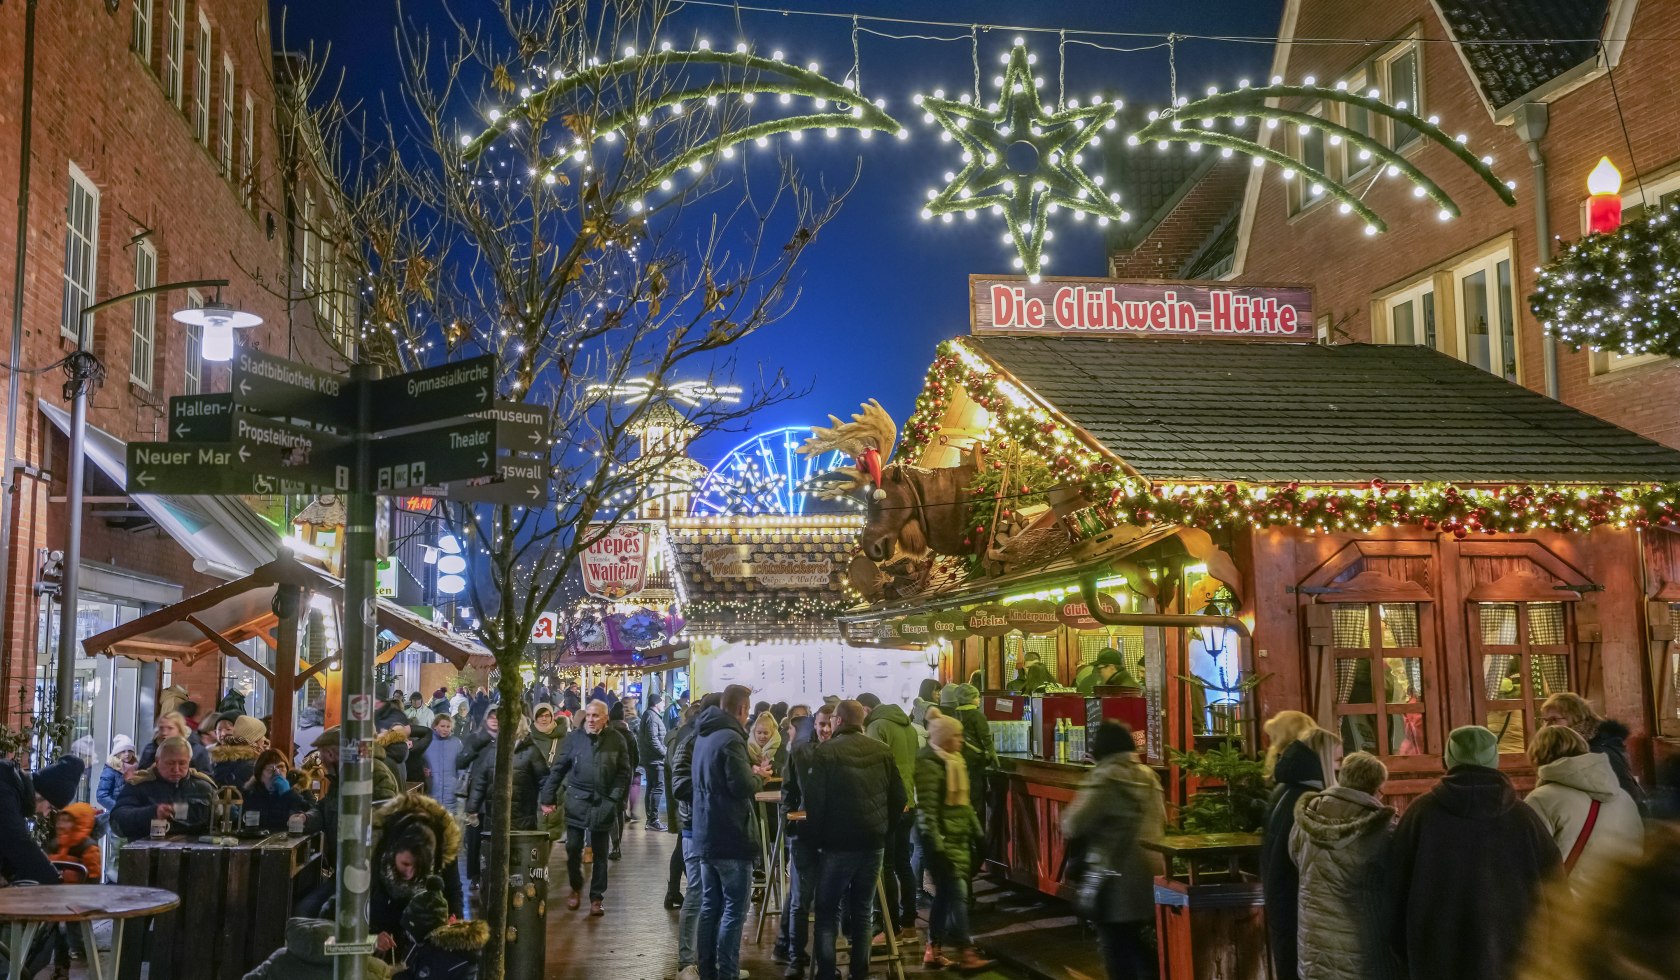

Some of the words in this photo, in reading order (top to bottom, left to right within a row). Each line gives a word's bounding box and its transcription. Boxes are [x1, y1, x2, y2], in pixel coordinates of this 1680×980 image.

[990, 284, 1045, 328] Die
[1053, 286, 1298, 334] Glühwein-Hütte
[240, 353, 316, 391] Stadtbibliothek
[319, 376, 339, 397] KÖB
[407, 365, 488, 397] Gymnasialkirche
[238, 420, 312, 451] Propsteikirche
[449, 431, 491, 449] Theater
[135, 449, 191, 465] Neuer
[199, 449, 231, 465] Mar
[588, 562, 639, 581] Waffeln
